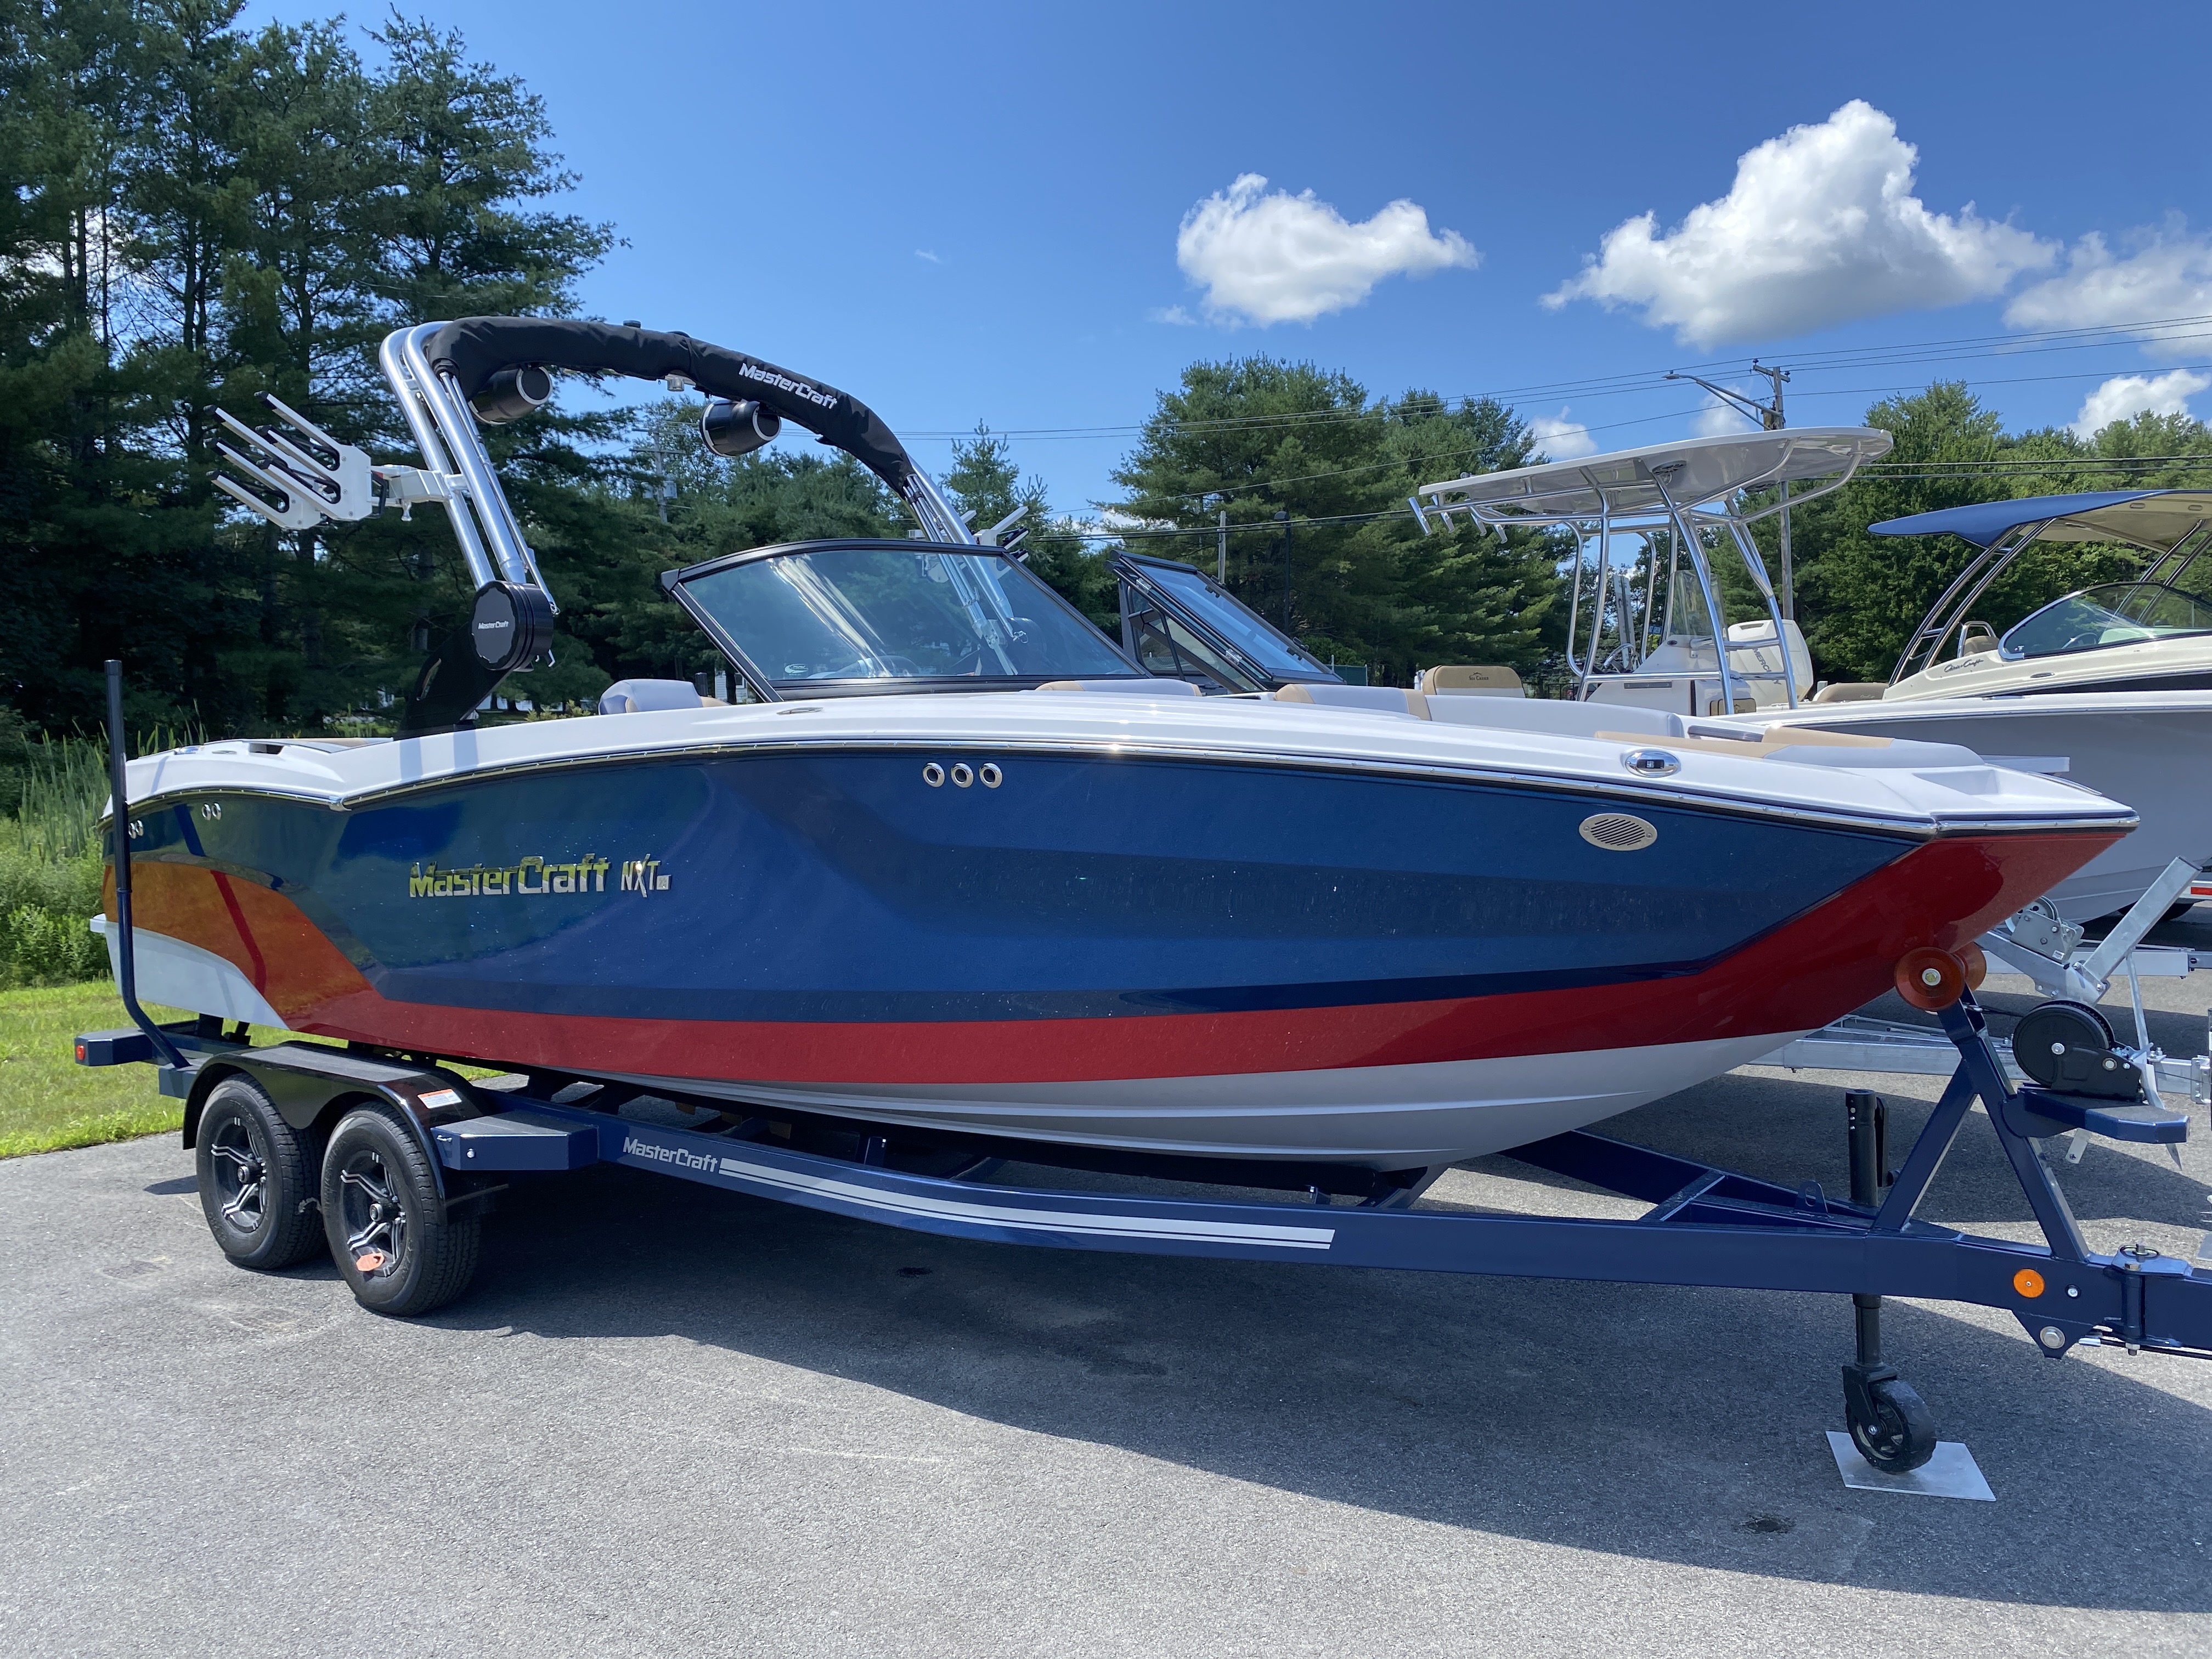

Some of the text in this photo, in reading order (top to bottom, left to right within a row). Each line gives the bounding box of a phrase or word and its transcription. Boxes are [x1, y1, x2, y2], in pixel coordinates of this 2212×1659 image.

[738, 363, 838, 410] MasterCraft
[1753, 647, 1782, 685] MERCY
[409, 853, 611, 898] MasterCraft
[620, 853, 661, 898] NXT
[622, 1136, 718, 1172] MasterCraft
